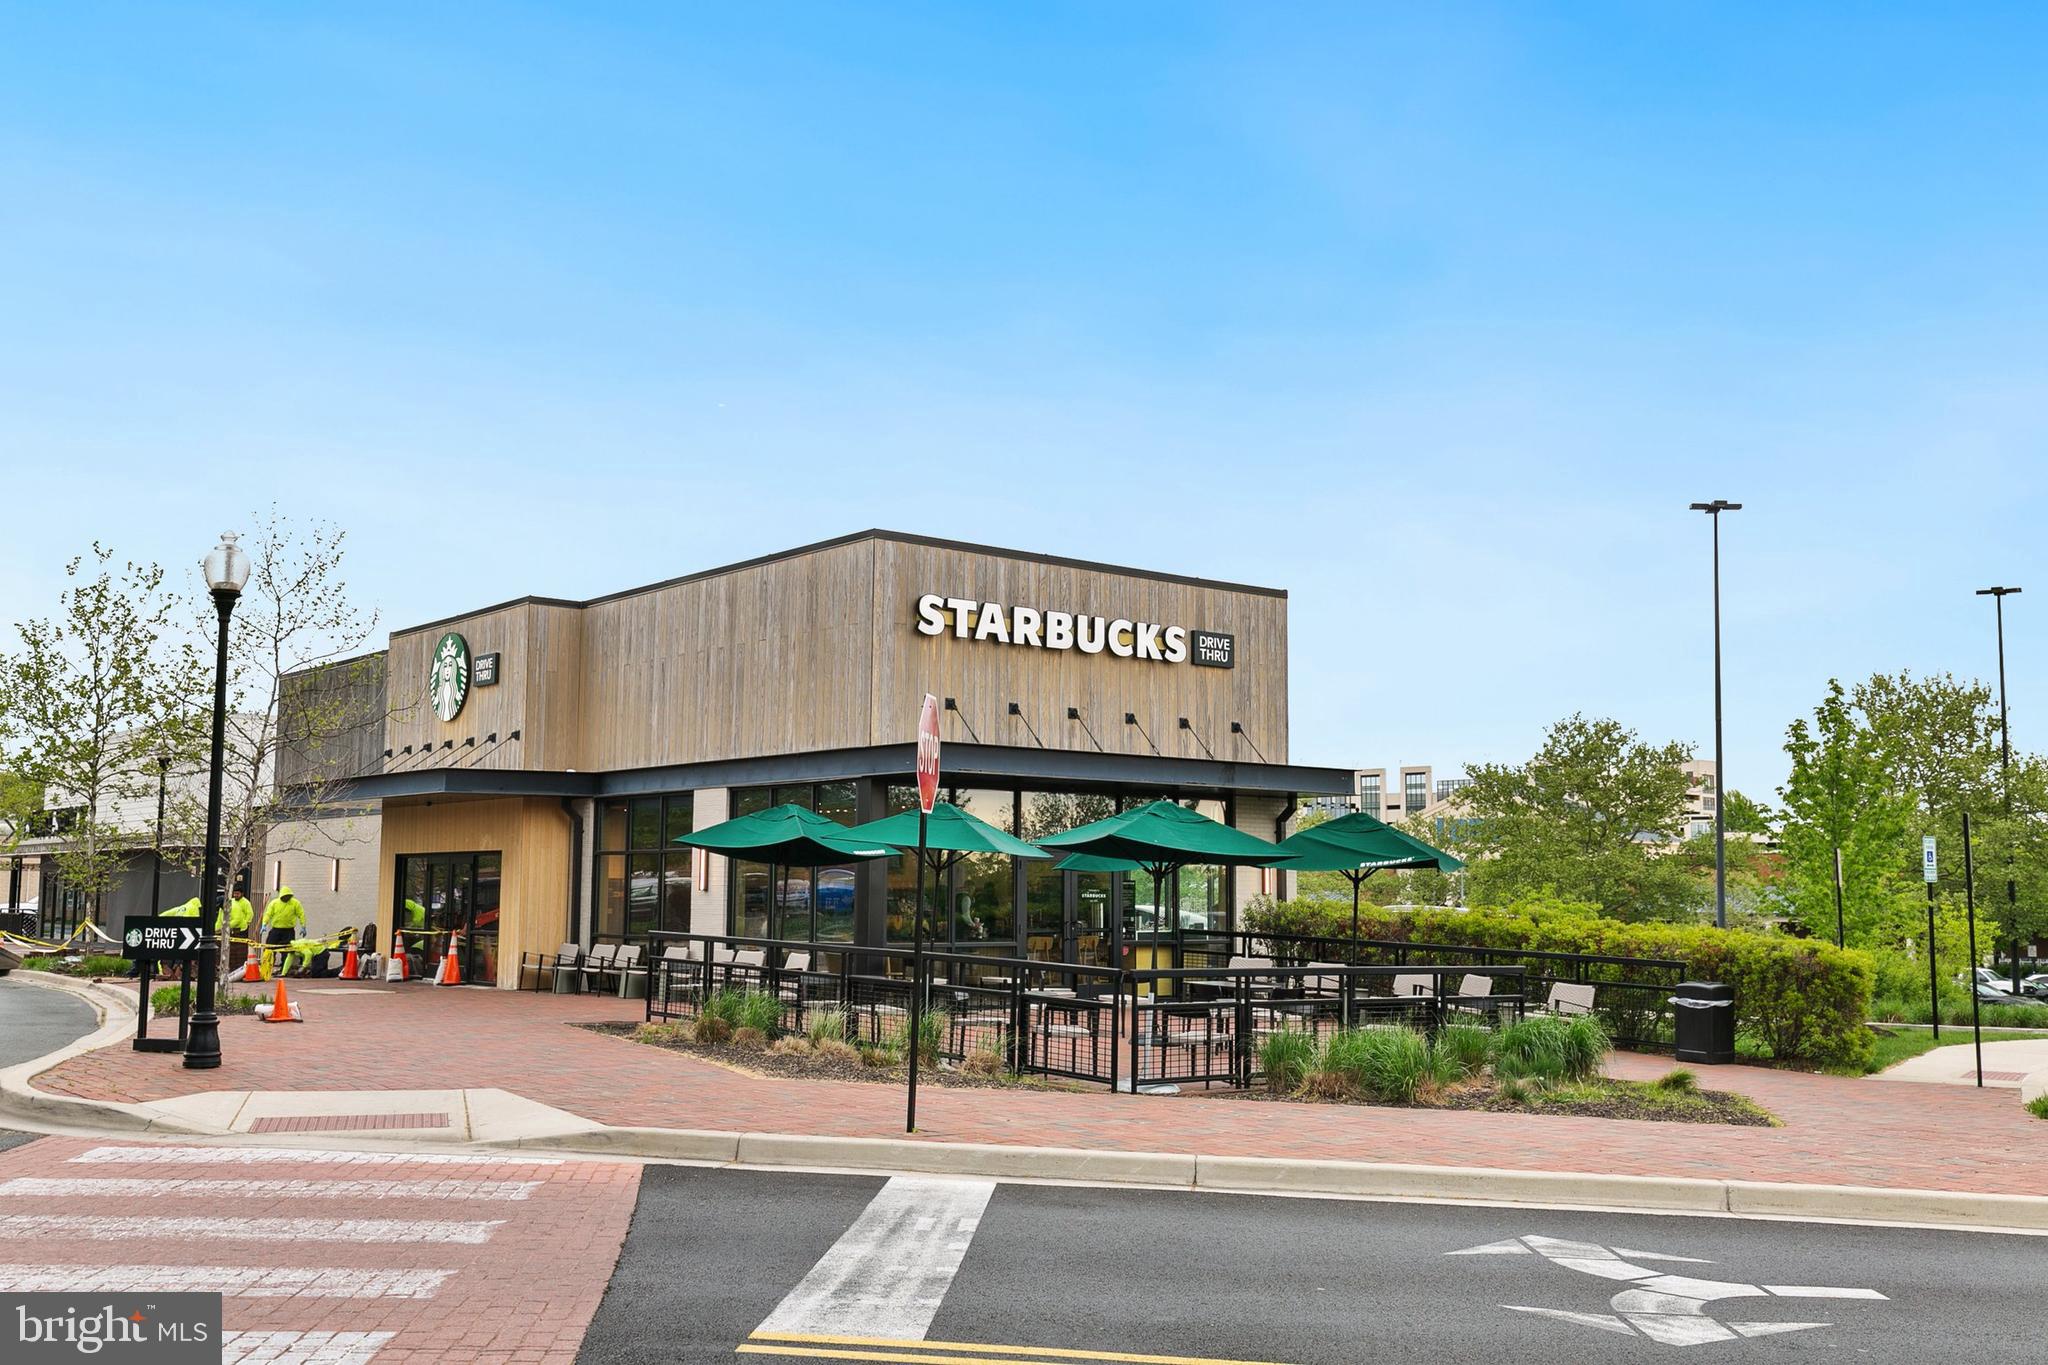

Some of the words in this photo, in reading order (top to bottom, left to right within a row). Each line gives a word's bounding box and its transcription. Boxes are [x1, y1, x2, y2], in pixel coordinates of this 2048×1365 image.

[917, 594, 1187, 663] STARBUCKS
[1199, 636, 1230, 650] DRIVE
[1199, 648, 1228, 662] THRU
[475, 657, 493, 670] DRIVE
[475, 669, 491, 682] THRU
[919, 730, 939, 776] STOP
[144, 927, 178, 939] DRIVE
[144, 938, 175, 949] THRU
